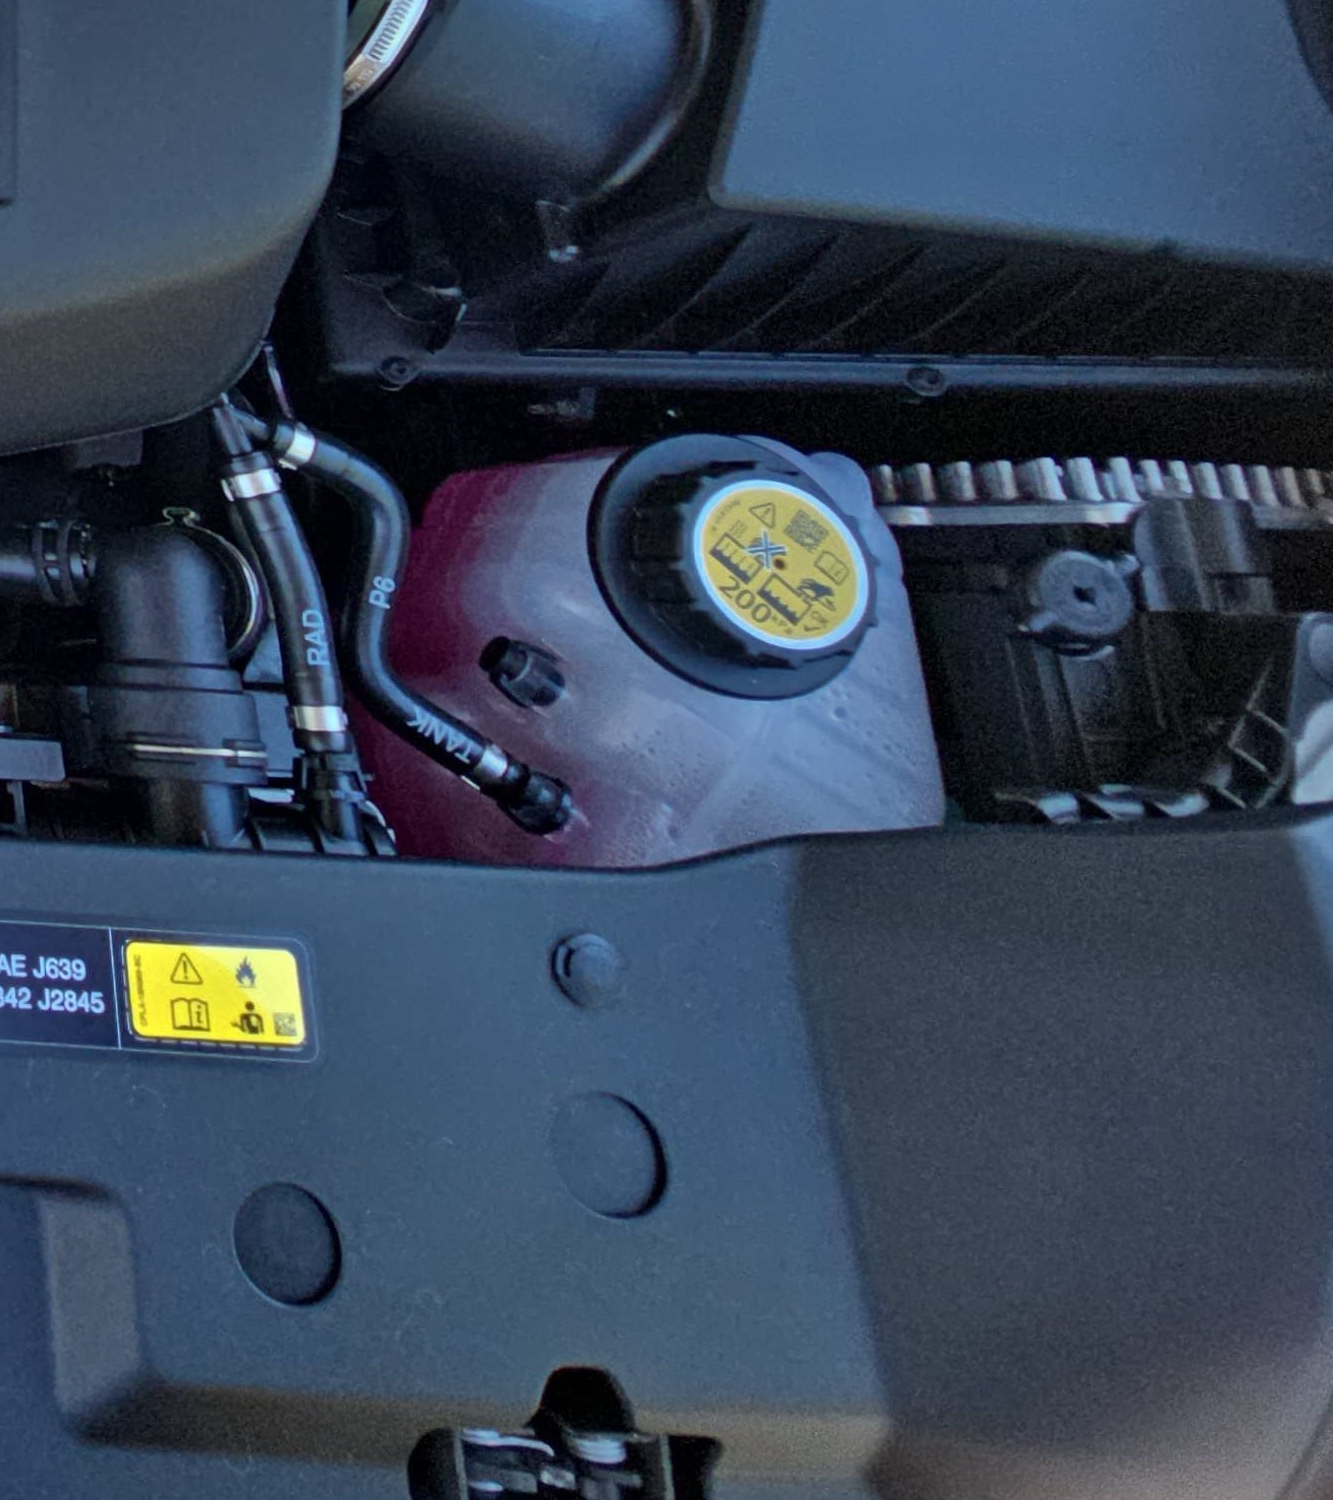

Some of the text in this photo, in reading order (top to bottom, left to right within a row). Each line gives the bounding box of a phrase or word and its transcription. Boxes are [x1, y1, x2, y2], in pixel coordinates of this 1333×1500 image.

[366, 574, 398, 611] P6
[719, 574, 774, 624] 200
[301, 607, 331, 667] RAD
[406, 705, 474, 765] TANK
[32, 955, 87, 983] J639
[36, 986, 106, 1015] J2845
